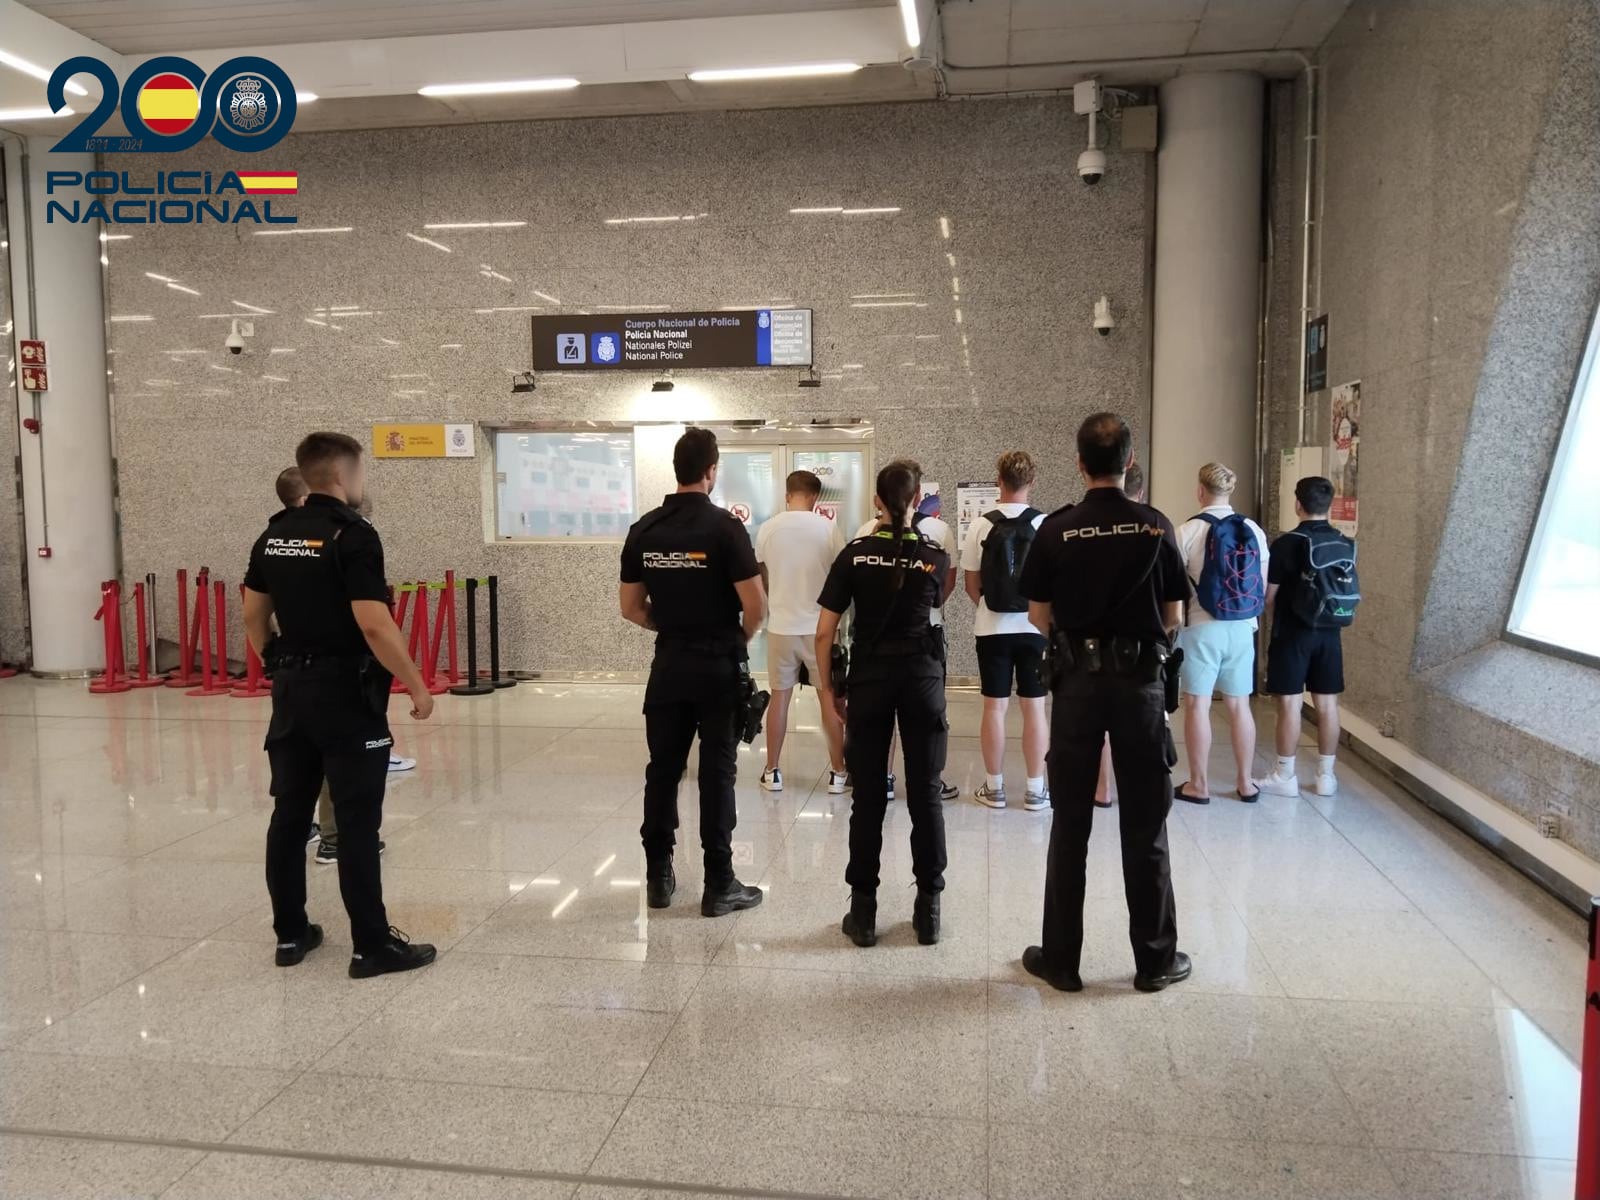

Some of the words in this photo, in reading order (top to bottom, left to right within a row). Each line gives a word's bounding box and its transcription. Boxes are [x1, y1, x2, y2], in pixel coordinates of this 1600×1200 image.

[625, 319, 657, 329] Cuerpo
[658, 318, 696, 328] Nacional
[698, 318, 709, 327] de
[653, 329, 688, 339] Nacional
[625, 340, 666, 350] Nationales
[667, 339, 693, 350] Polizei
[625, 351, 658, 361] National
[660, 351, 684, 361] Police
[264, 547, 321, 557] NACIONAL
[643, 560, 708, 568] NACIONAL
